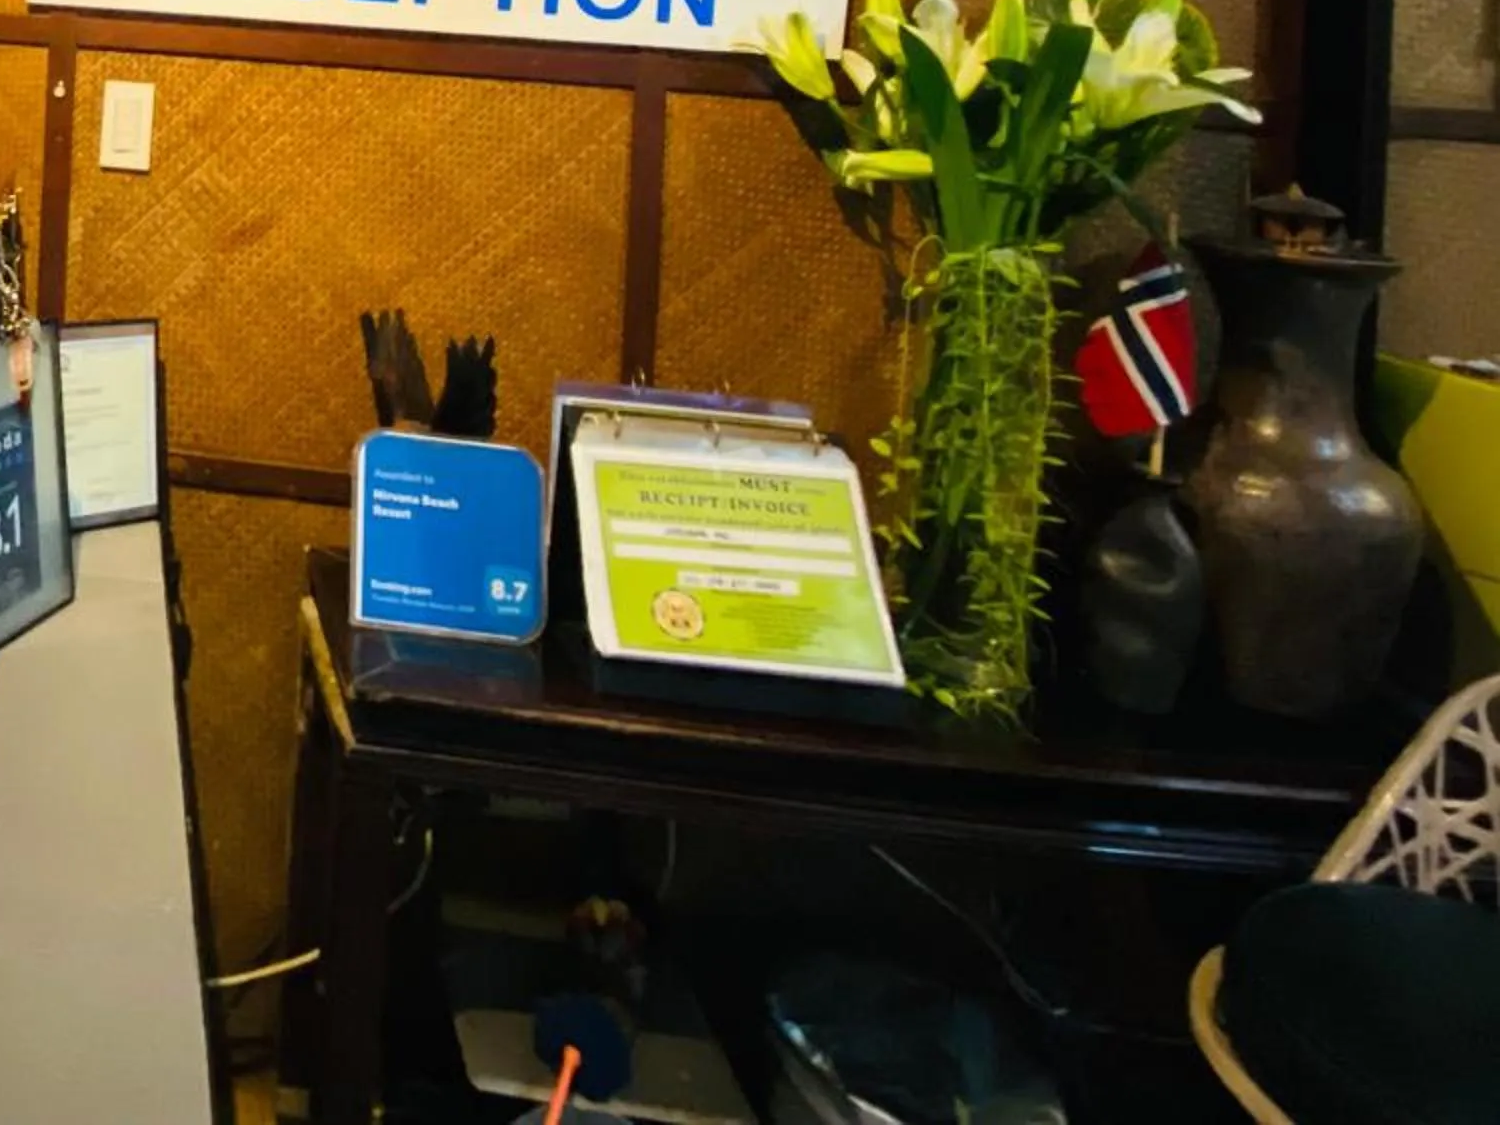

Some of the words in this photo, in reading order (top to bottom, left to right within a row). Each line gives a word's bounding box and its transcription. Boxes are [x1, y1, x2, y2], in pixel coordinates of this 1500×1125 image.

[739, 476, 792, 494] MUST
[421, 494, 460, 511] Beach
[489, 577, 529, 603] 8.7
